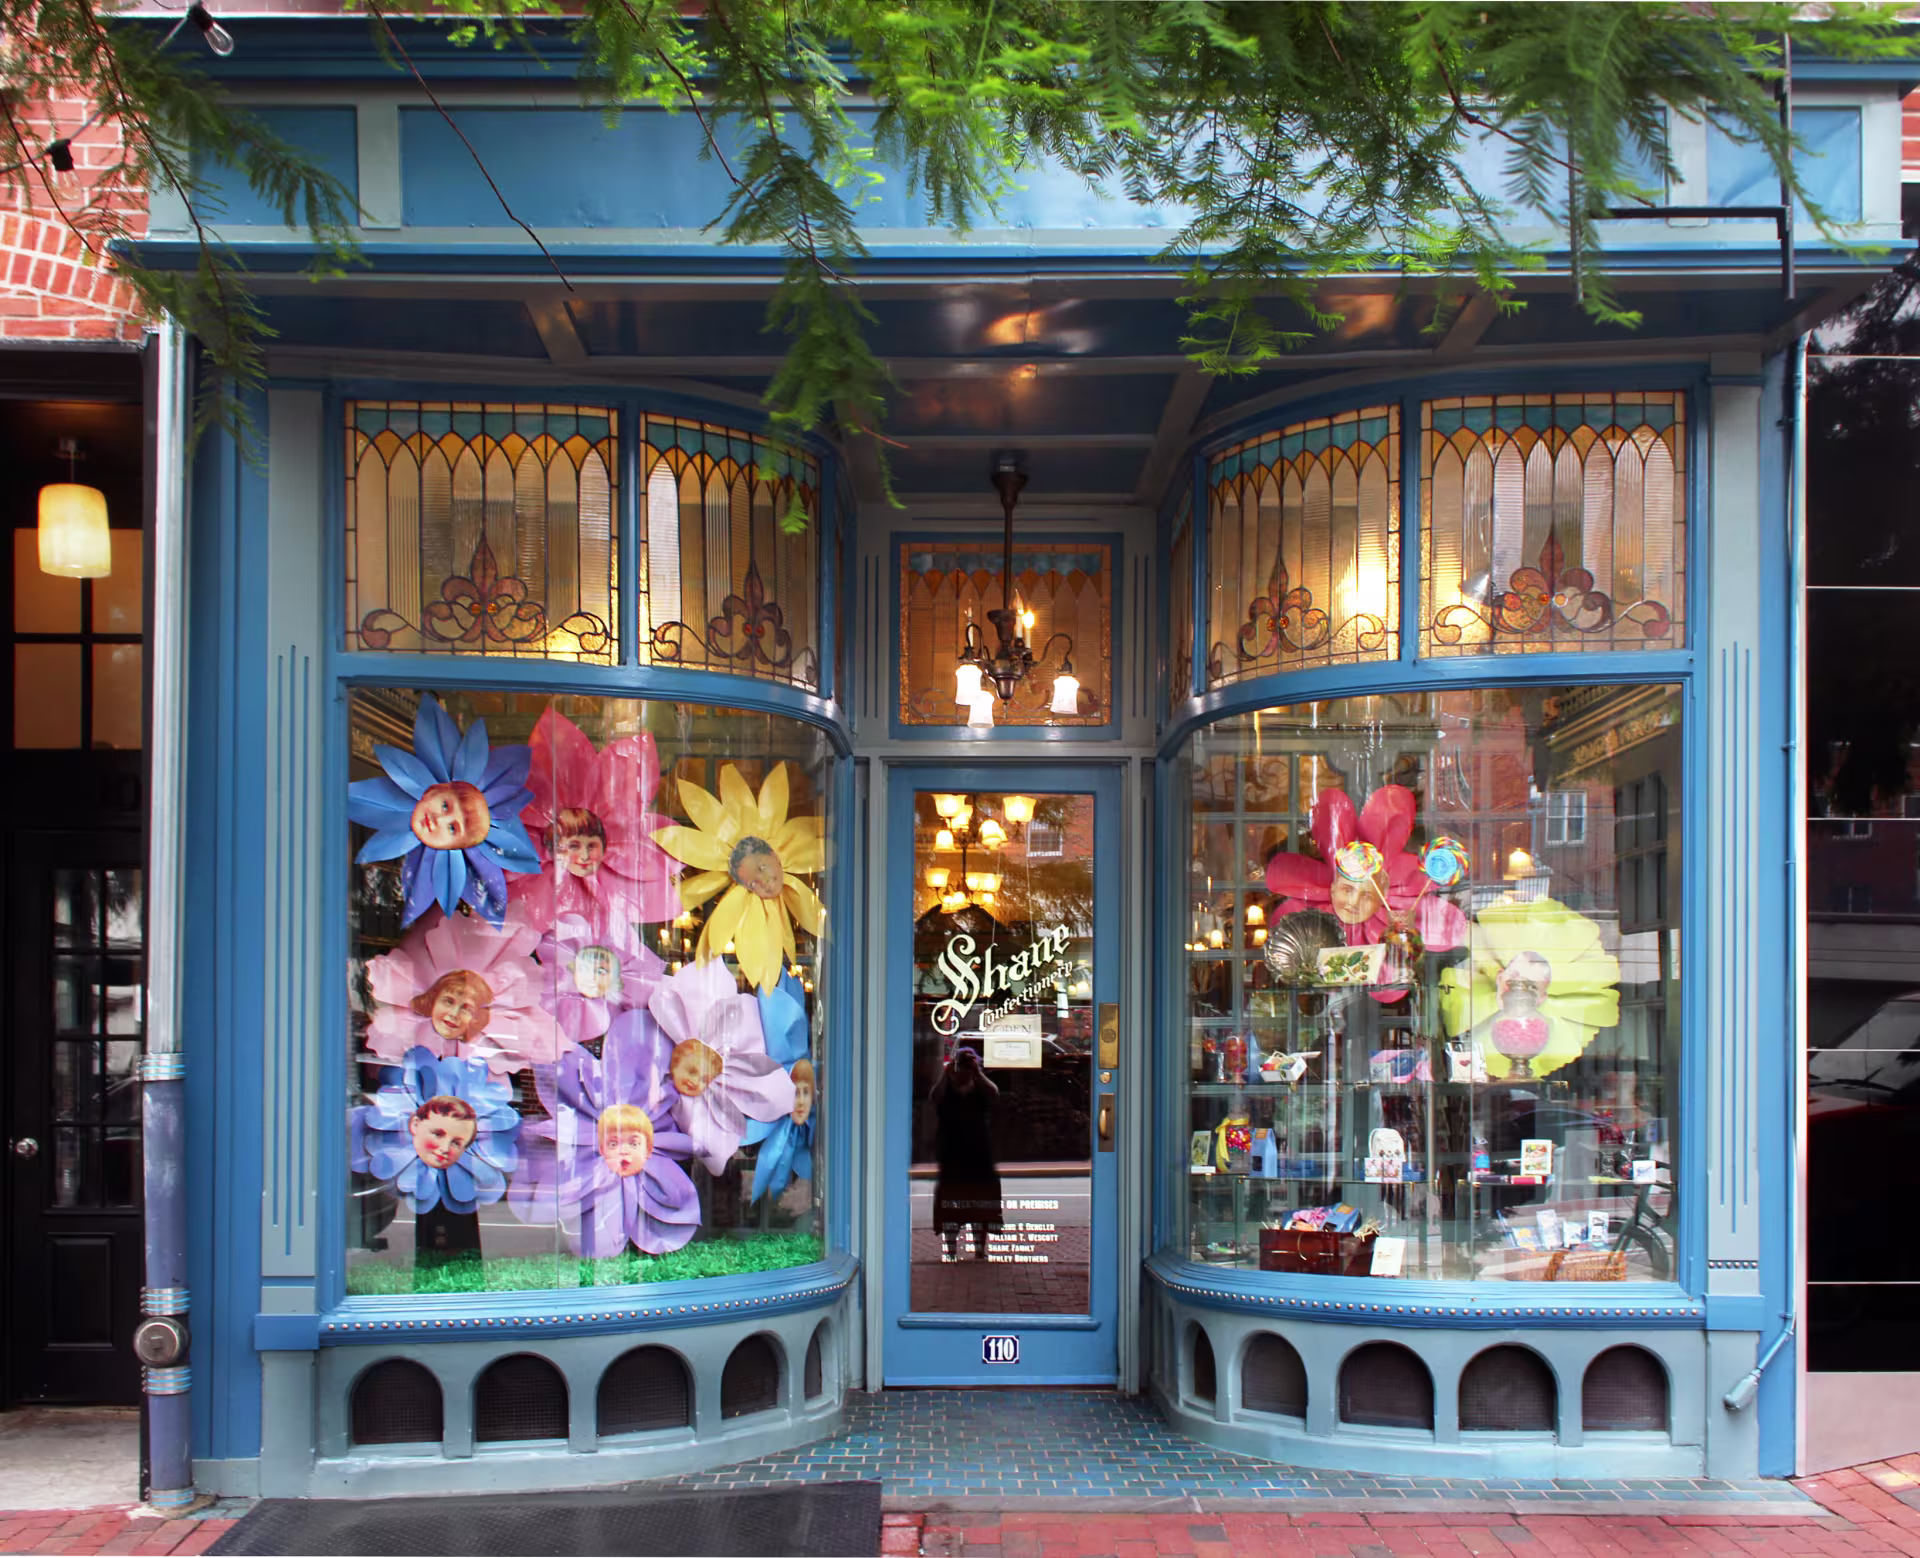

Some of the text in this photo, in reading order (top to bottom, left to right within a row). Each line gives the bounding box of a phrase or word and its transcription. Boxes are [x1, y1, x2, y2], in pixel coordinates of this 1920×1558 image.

[931, 923, 1071, 1036] Shane
[978, 960, 1073, 1032] Confectionery
[1006, 1199, 1018, 1210] ON
[1019, 1199, 1059, 1210] PREMISES
[988, 1232, 1018, 1242] WILLIAM
[1028, 1233, 1059, 1242] WESCOTT
[988, 1243, 1010, 1252] SHANE
[1011, 1243, 1035, 1252] FAMILY
[1014, 1254, 1049, 1263] BROTHERS
[988, 1338, 1015, 1361] 110
